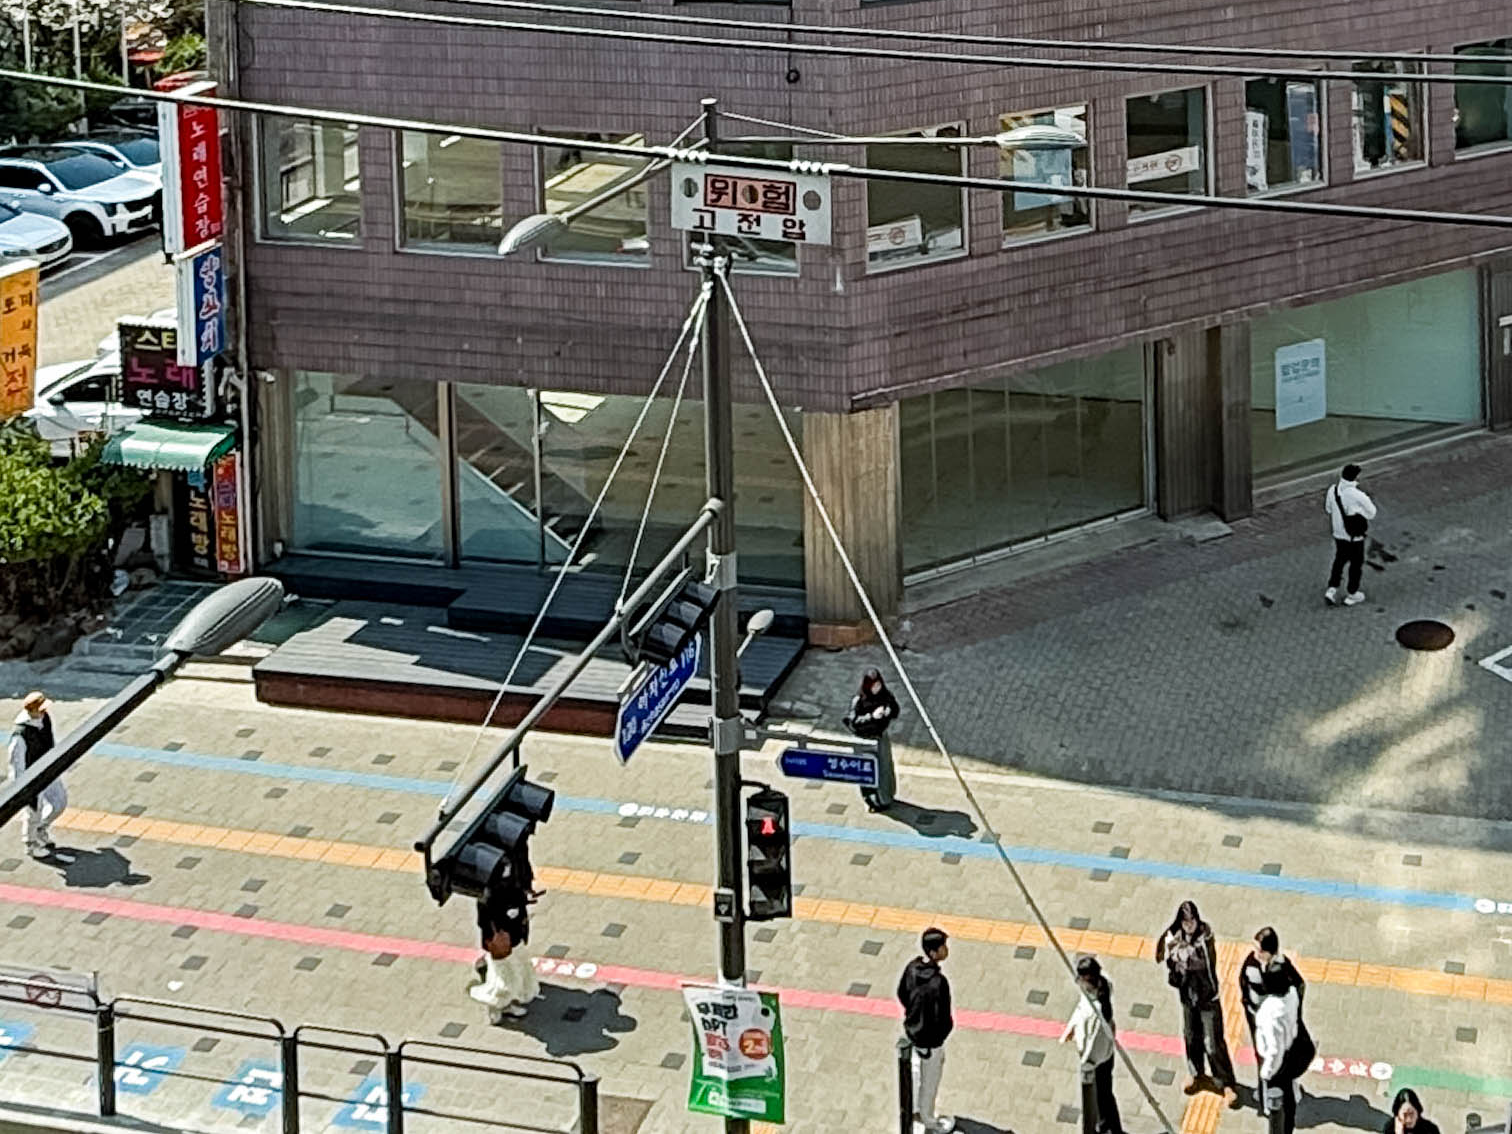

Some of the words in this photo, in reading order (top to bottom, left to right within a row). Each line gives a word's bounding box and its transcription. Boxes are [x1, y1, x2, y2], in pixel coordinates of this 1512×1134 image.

[190, 120, 211, 239] 노래연습장
[709, 178, 791, 211] 위험
[692, 208, 806, 242] 고전압
[128, 357, 196, 391] 노래
[136, 388, 188, 411] 연습장
